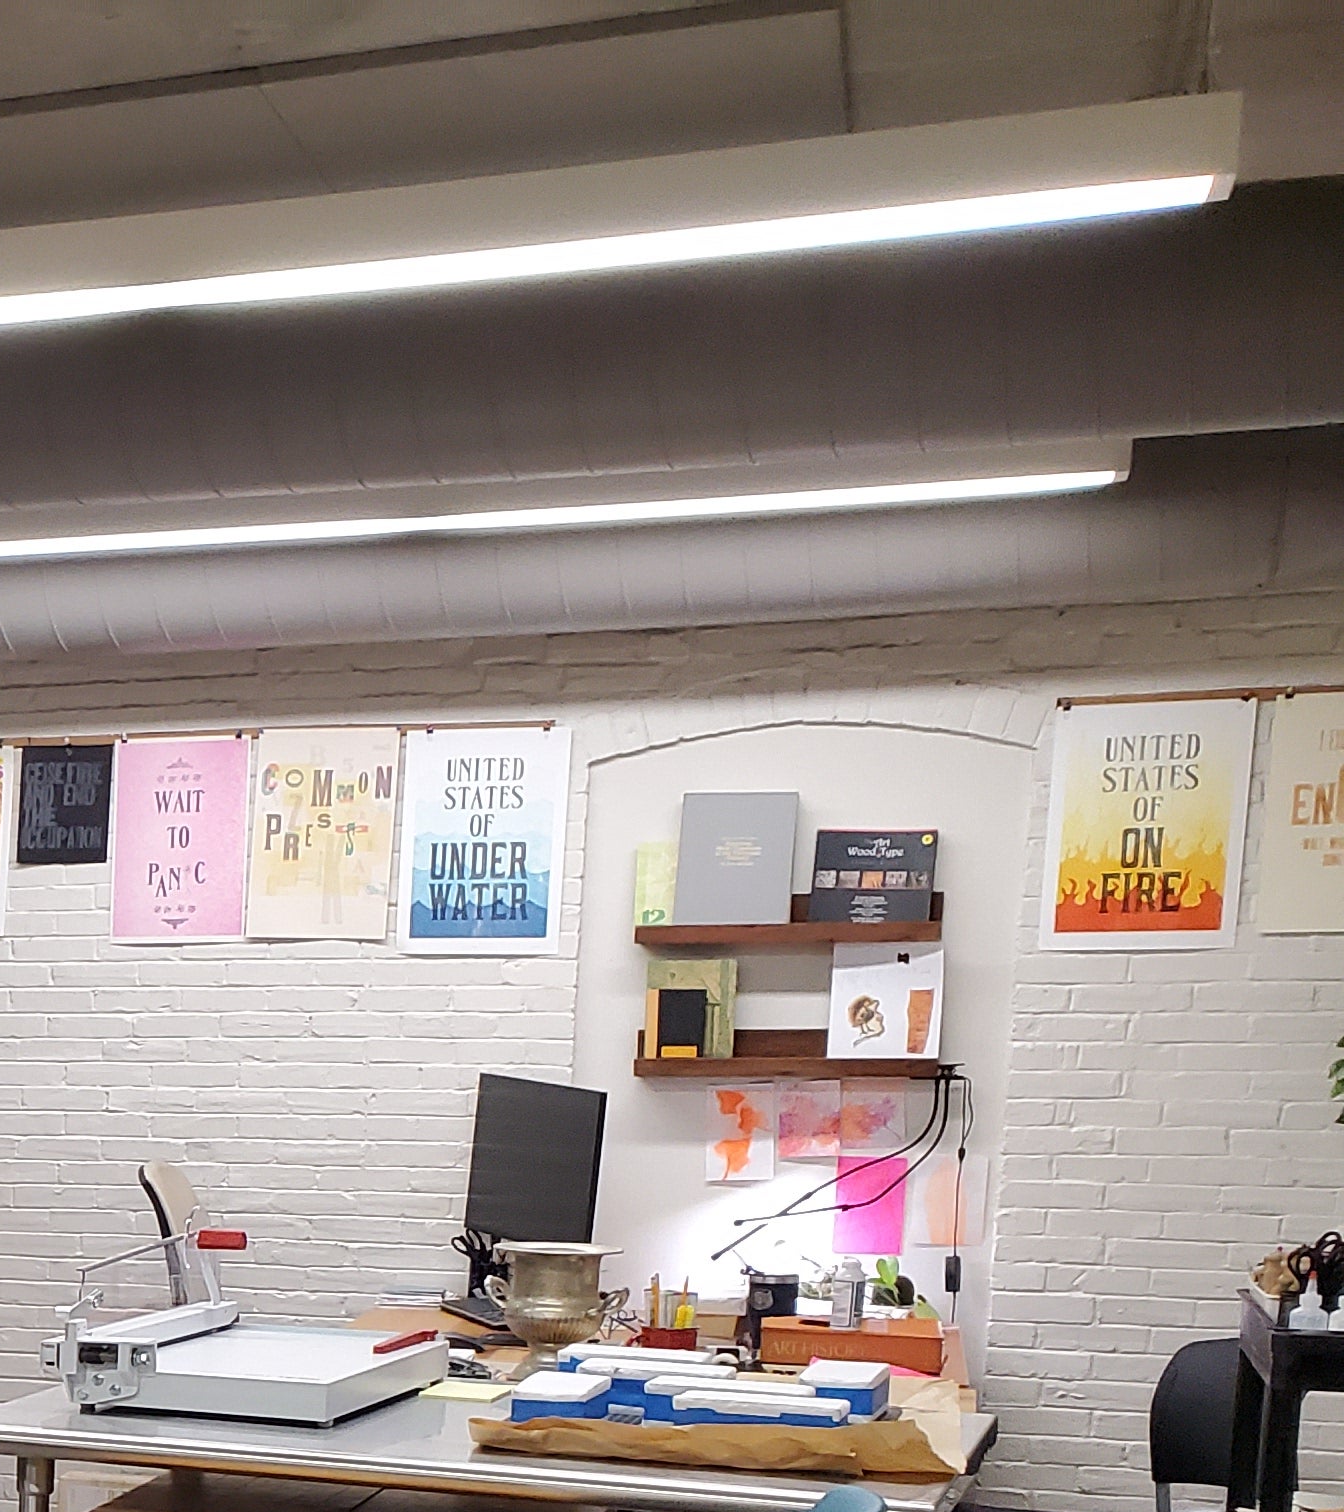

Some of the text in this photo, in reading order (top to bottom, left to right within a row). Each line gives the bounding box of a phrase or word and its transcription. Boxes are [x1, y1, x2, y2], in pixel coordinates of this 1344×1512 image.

[1105, 733, 1201, 762] UNITED
[447, 757, 525, 782] UNITED
[1102, 764, 1200, 793] STATES
[261, 763, 393, 807] COMMON
[444, 785, 524, 810] STATES
[154, 789, 206, 815] WAIT
[1133, 796, 1164, 822] OF
[166, 826, 190, 848] TO
[469, 814, 495, 837] OF
[430, 841, 527, 881] UNDER
[1120, 827, 1165, 868] ON
[428, 883, 529, 922] WATER
[1098, 871, 1183, 914] FIRE
[768, 1340, 864, 1357] ART HISTORY
